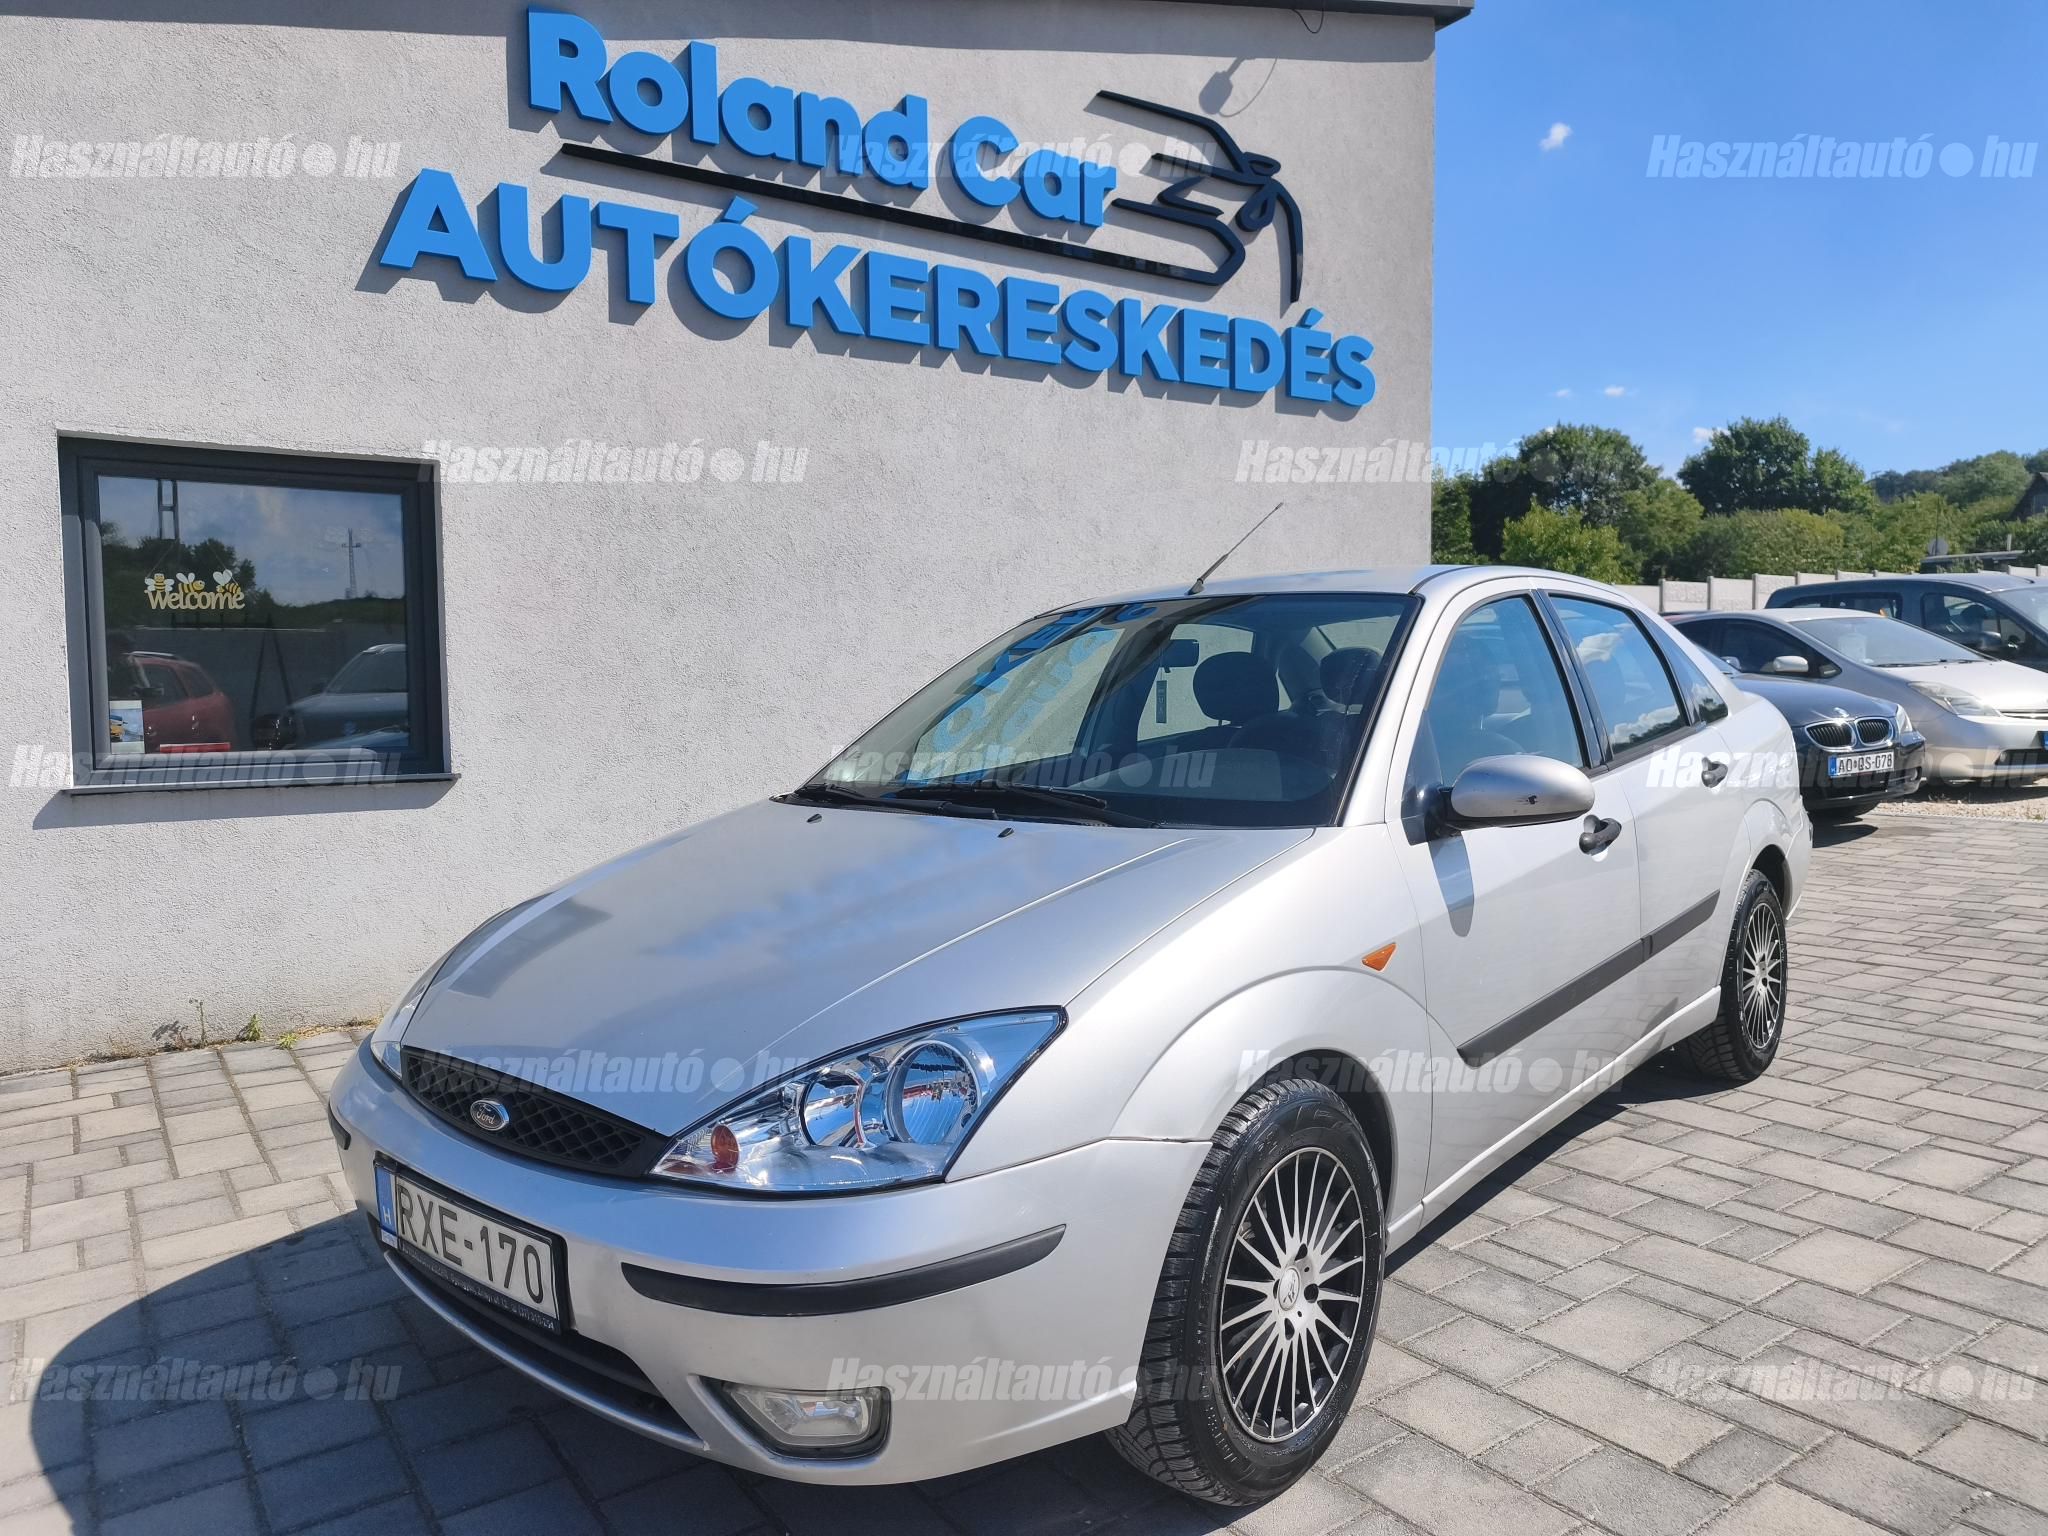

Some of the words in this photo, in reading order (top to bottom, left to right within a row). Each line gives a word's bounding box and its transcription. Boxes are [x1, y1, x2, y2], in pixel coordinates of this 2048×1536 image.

[527, 10, 928, 191] Roland
[949, 115, 1117, 228] Car
[379, 167, 1376, 407] AUTÓKERESKEDÉS
[144, 589, 246, 610] Welcome
[383, 1206, 392, 1225] H
[398, 1183, 544, 1304] RXE-170
